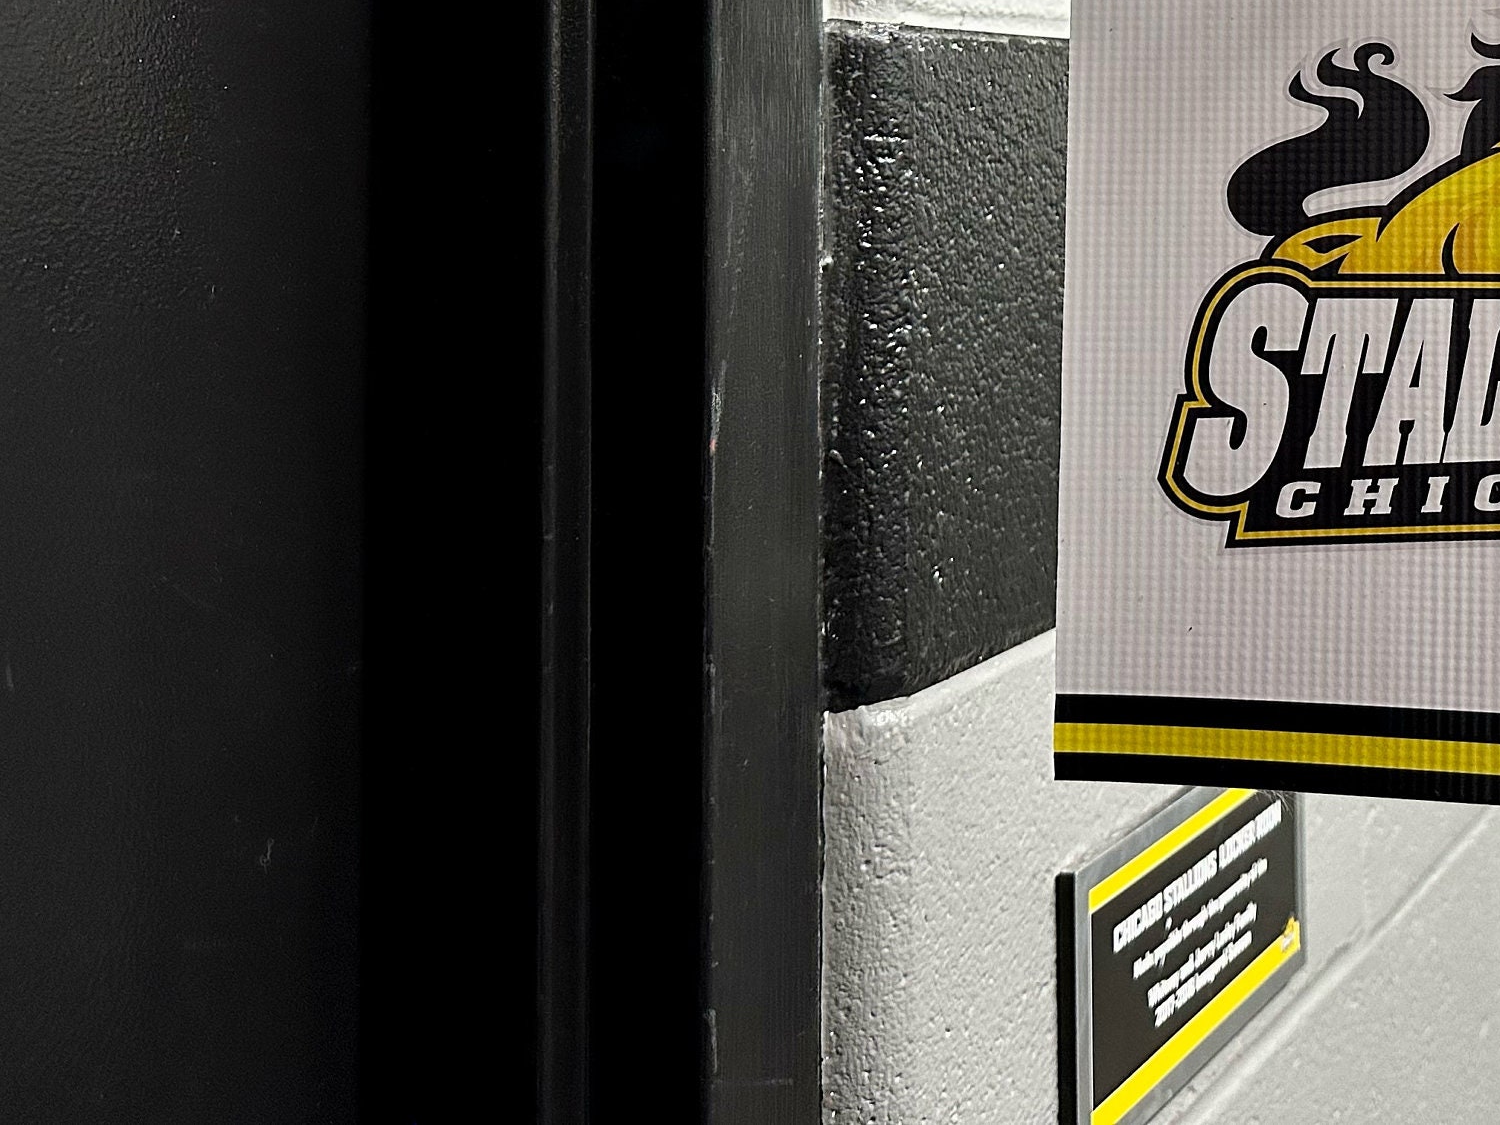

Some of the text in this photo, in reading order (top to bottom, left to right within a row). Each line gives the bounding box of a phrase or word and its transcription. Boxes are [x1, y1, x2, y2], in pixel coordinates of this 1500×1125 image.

[1113, 891, 1163, 954] CHICAGO
[1163, 849, 1217, 914] STALLIONS
[1218, 817, 1256, 869] LOCKER
